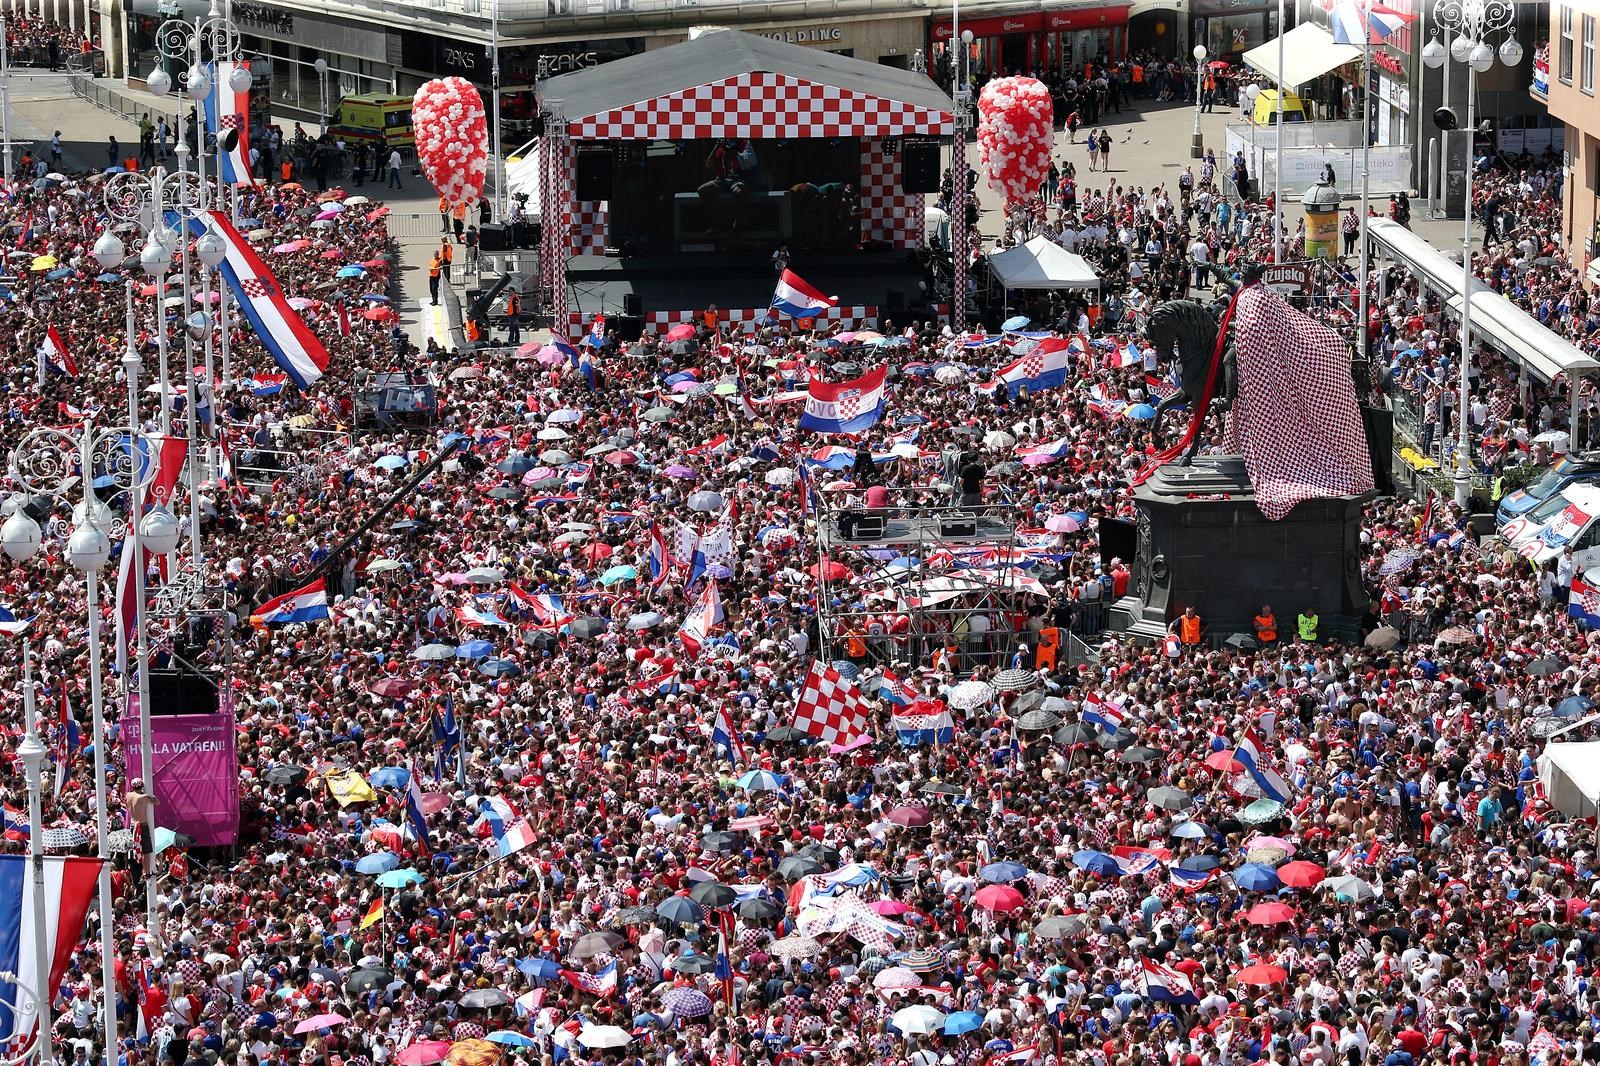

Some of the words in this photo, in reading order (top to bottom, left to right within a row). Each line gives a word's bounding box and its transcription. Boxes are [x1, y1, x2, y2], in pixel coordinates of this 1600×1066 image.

[447, 48, 475, 69] ZAKS
[546, 52, 598, 71] ZAKS
[1368, 160, 1393, 168] nteko
[172, 740, 225, 753] VATRENI!
